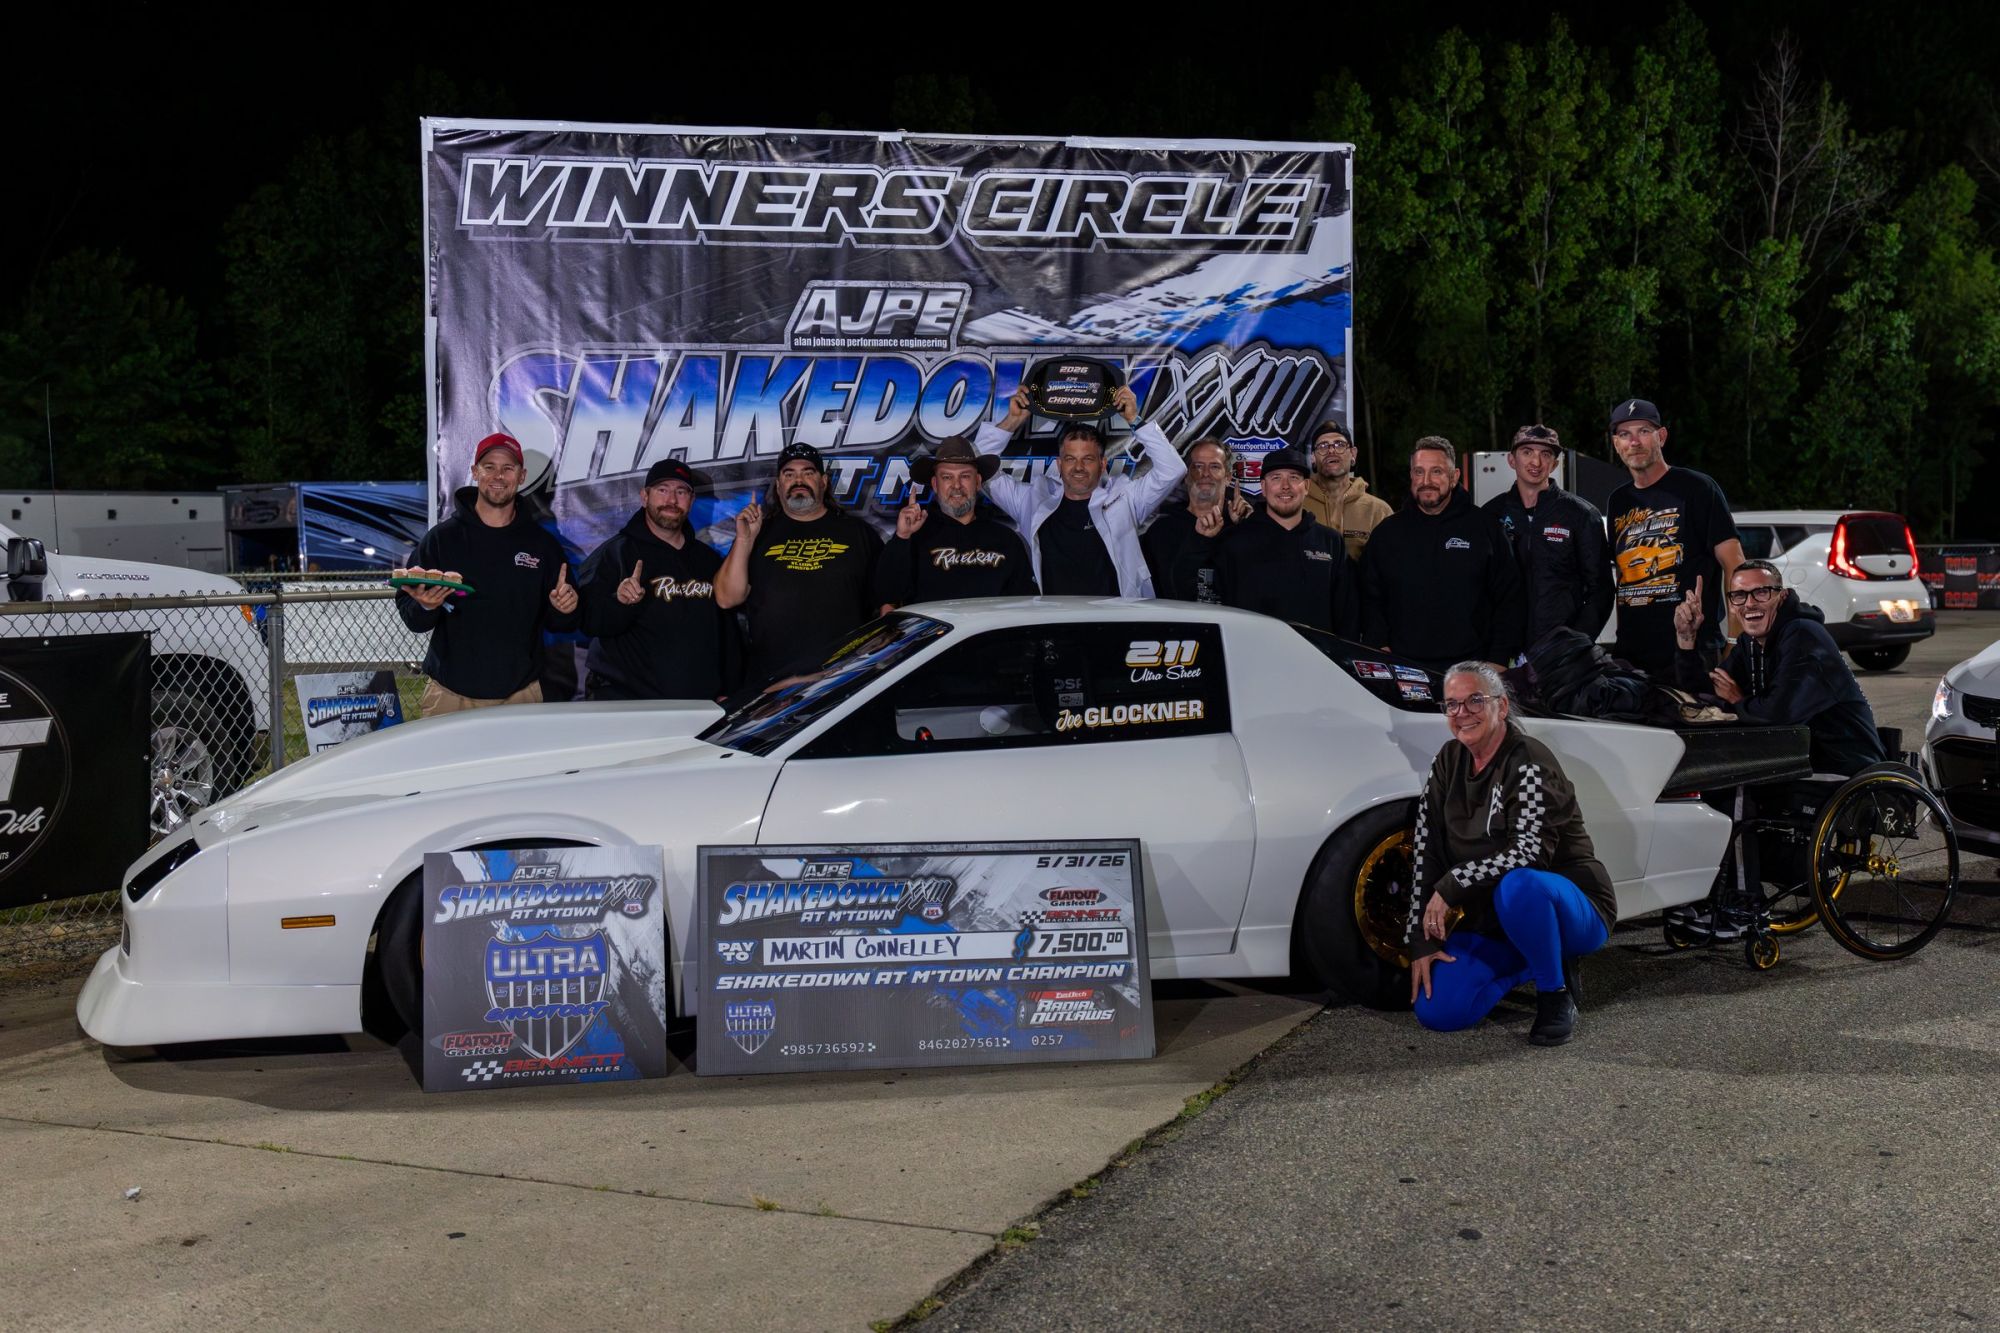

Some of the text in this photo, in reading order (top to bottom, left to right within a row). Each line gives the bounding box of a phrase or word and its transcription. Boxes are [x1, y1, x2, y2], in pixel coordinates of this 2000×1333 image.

[460, 157, 1314, 240] WINNERS CIRCLE
[793, 289, 963, 335] AJPE
[794, 337, 948, 349] alan johnson performance engineering
[1059, 365, 1089, 374] 2026
[1048, 396, 1097, 405] CHAMPION
[780, 540, 833, 560] BES
[1125, 640, 1200, 668] 211
[1131, 665, 1202, 682] Ultra Street
[308, 695, 379, 724] SHAKEDOWN
[1055, 700, 1205, 732] Joe GLOCKNER
[341, 713, 350, 721] AT
[1036, 855, 1125, 868] 5/31/26
[515, 866, 557, 880] AJPE
[804, 864, 850, 879] AJPE
[433, 877, 652, 925] SHAKEDOWN XXIII
[1049, 889, 1099, 900] FLATOUT
[719, 879, 906, 926] SHAKEDOWN
[510, 905, 599, 920] AT M'TOWN
[801, 909, 897, 923] AT M'TOWN
[1045, 908, 1121, 919] BENNETT
[717, 942, 755, 953] PAY
[769, 938, 845, 963] MARTIN
[493, 946, 600, 977] ULTRA
[725, 952, 750, 962] TO
[716, 964, 1125, 990] SHAKEDOWN AT M'TOWN CHAMPION
[495, 981, 598, 998] STREET
[728, 1005, 772, 1018] ULTRA
[1036, 1000, 1096, 1012] RADIAL
[1030, 1008, 1115, 1025] OUTLAWS
[445, 1034, 514, 1050] FLATOUT
[918, 1037, 1000, 1050] 8462027561
[1031, 1034, 1064, 1046] 0257
[445, 1046, 510, 1057] Gaskets
[790, 1042, 865, 1056] 985736592
[503, 1053, 625, 1072] BENNETT
[503, 1066, 622, 1079] RACING ENGINES
